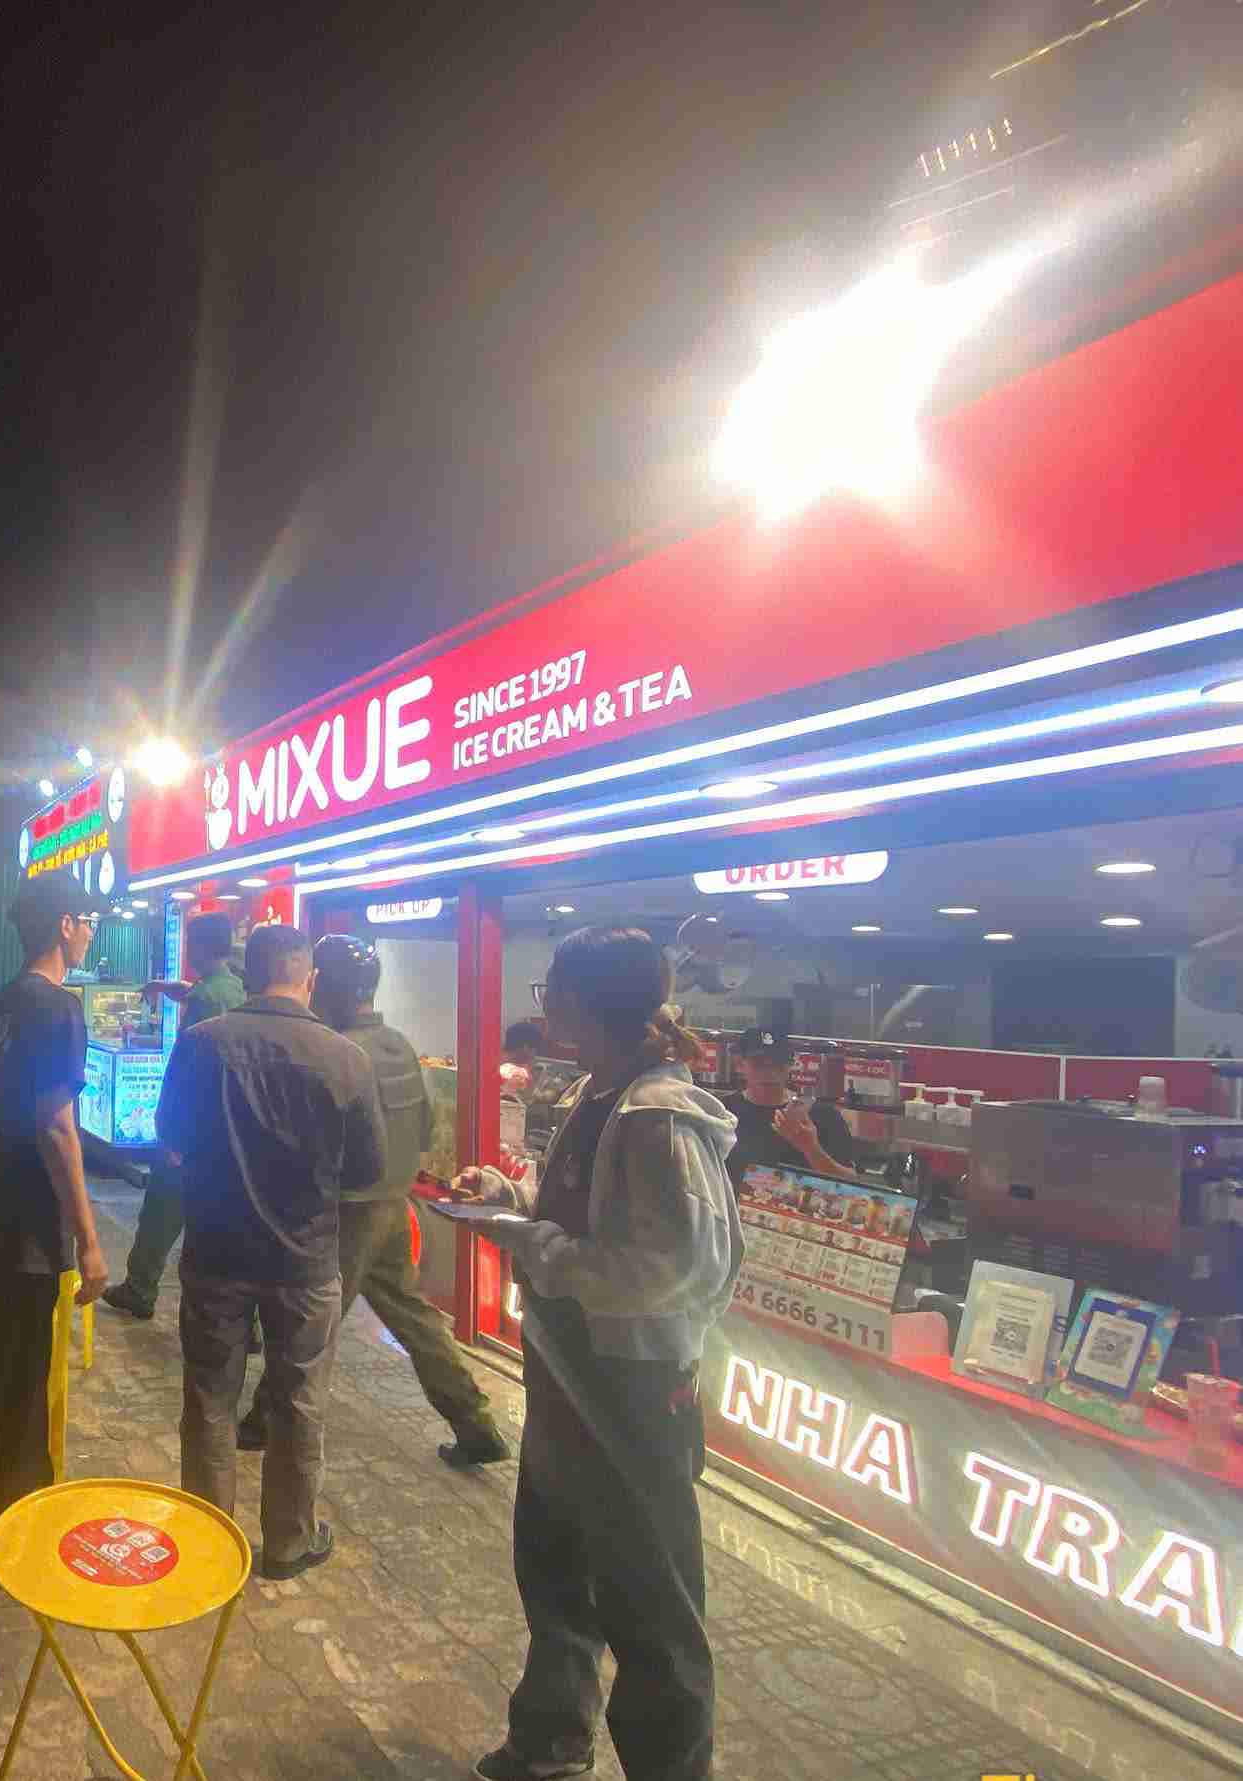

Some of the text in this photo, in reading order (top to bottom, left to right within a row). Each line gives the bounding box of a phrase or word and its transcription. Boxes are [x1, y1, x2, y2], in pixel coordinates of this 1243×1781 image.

[453, 649, 587, 729] SINCE 1997
[453, 664, 693, 770] ICE CREAM & TEA
[237, 676, 433, 836] MIXUE
[760, 1291, 818, 1328] 6666
[823, 1311, 885, 1351] 2111
[720, 1355, 1243, 1658] NHA TRA
